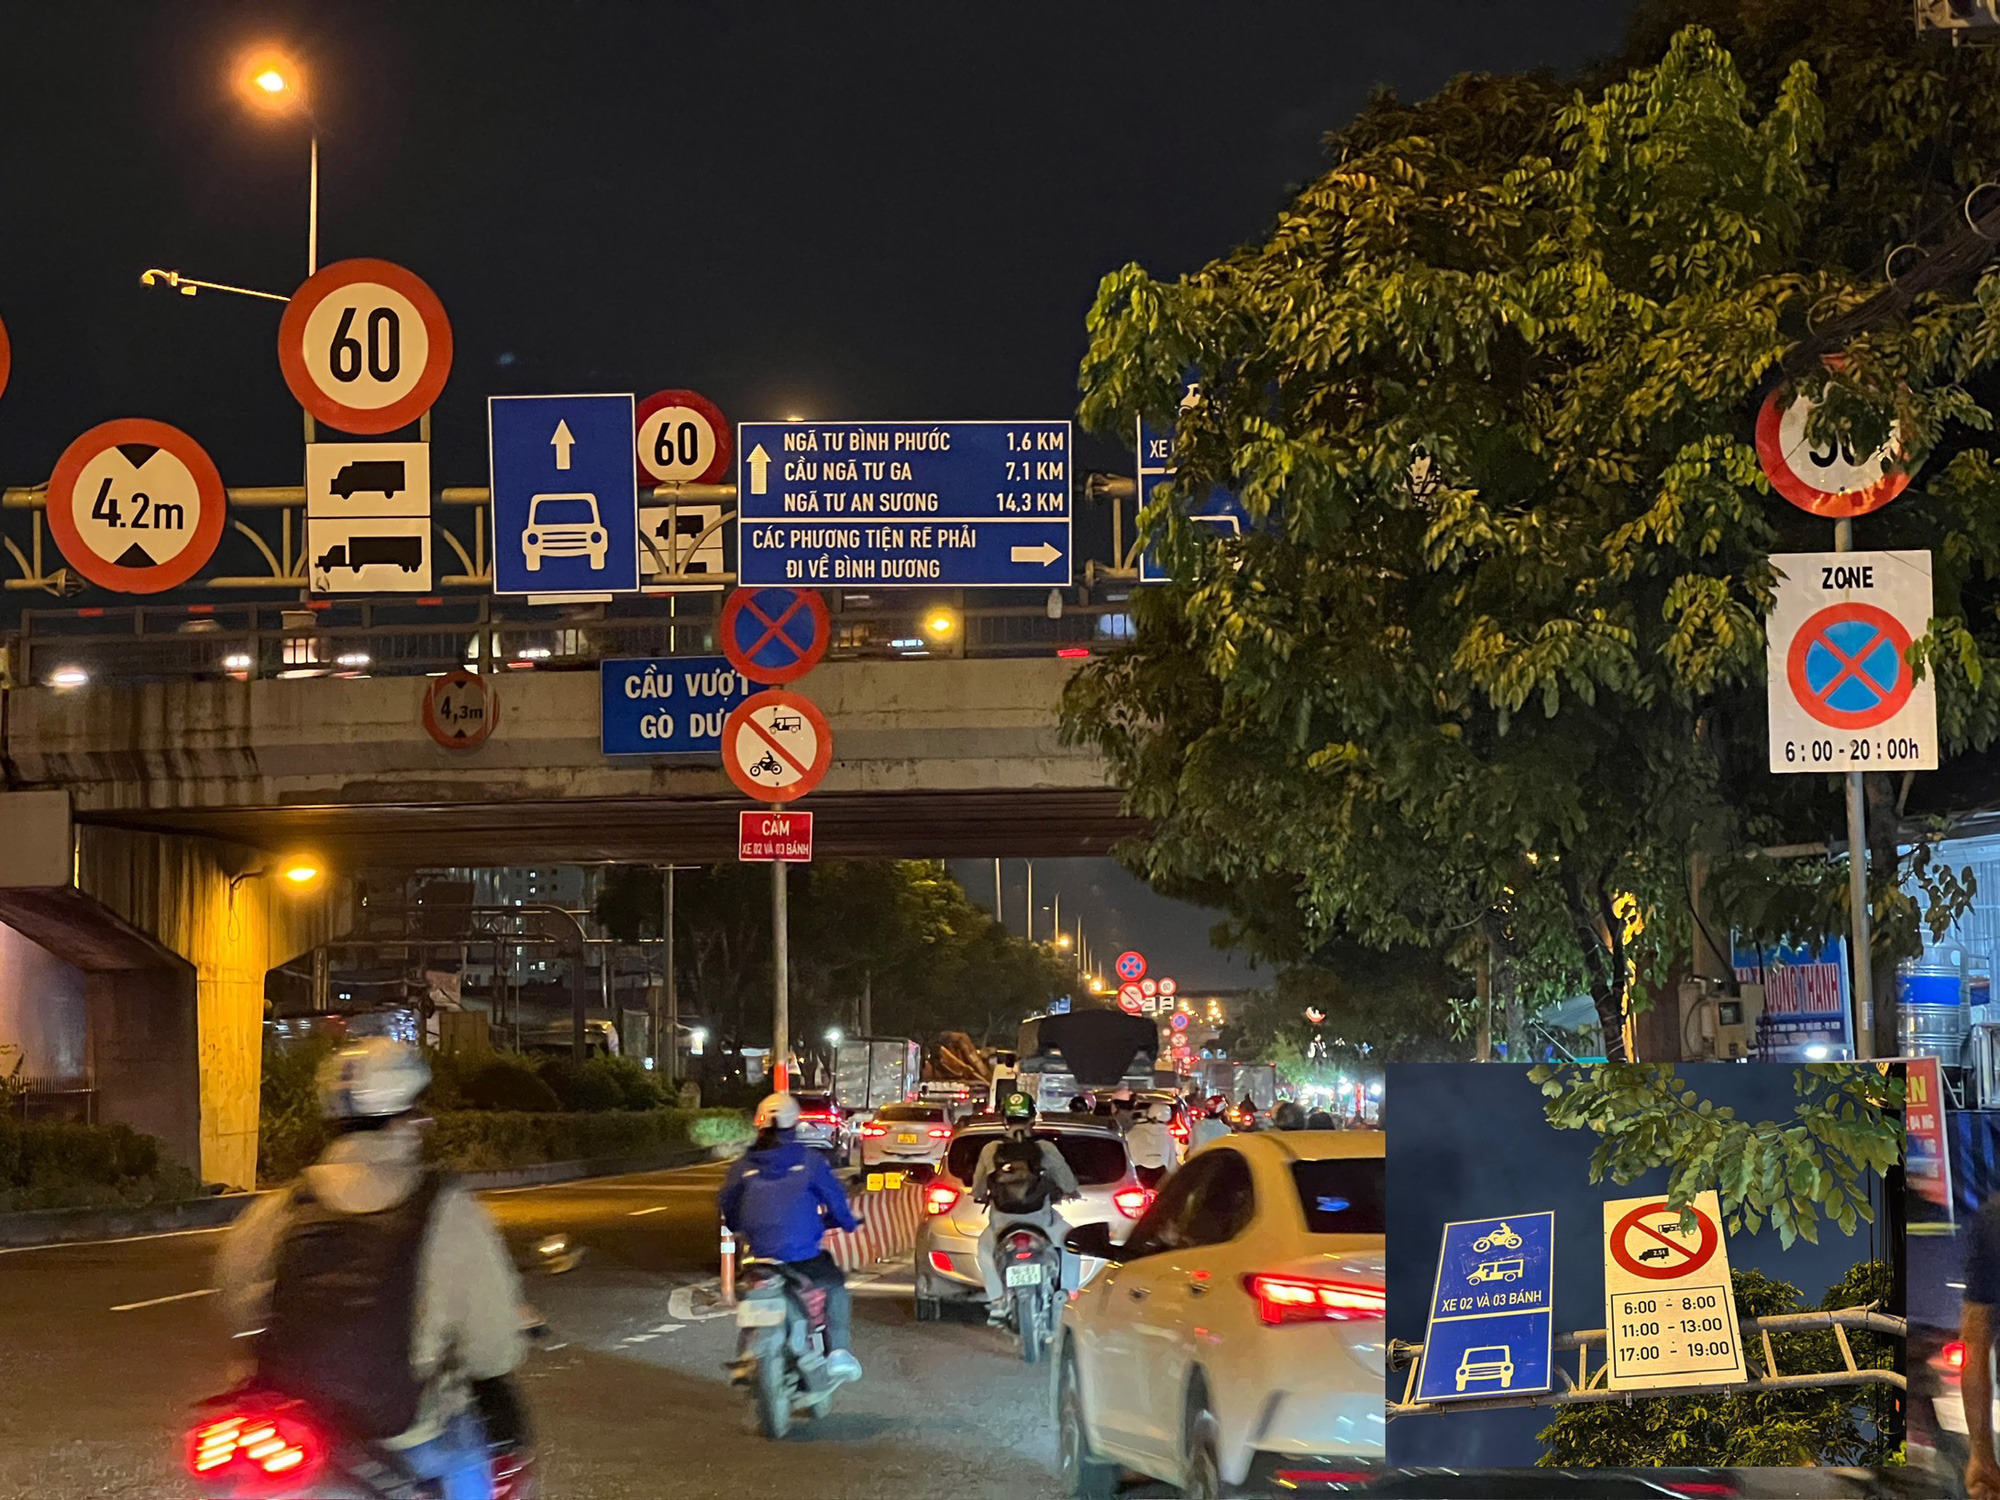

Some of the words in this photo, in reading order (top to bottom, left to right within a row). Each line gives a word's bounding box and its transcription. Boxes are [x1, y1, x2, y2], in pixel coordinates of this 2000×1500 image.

[329, 307, 400, 383] 60
[654, 422, 698, 466] 60
[784, 430, 818, 451] NGÃ
[823, 432, 845, 451] TƯ
[850, 429, 888, 451] BÌNH
[895, 428, 950, 451] PHƯỚC
[1007, 432, 1031, 452] 1,6
[1037, 432, 1064, 450] KM
[1150, 440, 1168, 458] XE
[784, 456, 817, 481] CẦU
[823, 459, 858, 481] NGÃ
[863, 461, 885, 480] TƯ
[890, 462, 912, 480] GA
[1006, 462, 1030, 482] 7,1
[1037, 462, 1063, 480] KM
[91, 477, 184, 530] 4.2m
[784, 490, 818, 512] NGÃ
[823, 493, 846, 512] TƯ
[852, 494, 874, 512] AN
[879, 492, 938, 512] SƯƠNG
[996, 493, 1031, 514] 14,3
[1037, 494, 1063, 511] KM
[752, 525, 785, 548] CÁC
[790, 529, 860, 548] PHƯƠNG
[865, 526, 904, 551] TIỆN
[911, 527, 932, 548] RẼ
[938, 525, 976, 548] PHẢI
[786, 559, 803, 578] ĐI
[808, 553, 830, 578] VỀ
[835, 554, 875, 578] BÌNH
[881, 559, 940, 578] DƯƠNG
[1822, 566, 1874, 589] ZONE
[625, 664, 673, 698] CẦU
[685, 667, 749, 702] VƯỢT
[441, 696, 483, 724] 4,3m
[640, 708, 674, 739] GÒ
[690, 708, 732, 738] DƯ
[742, 843, 753, 855] XE
[753, 843, 763, 855] 02
[764, 840, 773, 855] VÀ
[775, 843, 785, 855] 03
[786, 840, 809, 855] BÁNH
[1441, 1298, 1457, 1312] XE
[1460, 1297, 1473, 1310] 02
[1476, 1292, 1490, 1308] VÀ
[1493, 1293, 1506, 1306] 03
[1509, 1289, 1542, 1305] BÁNH
[1624, 1300, 1657, 1315] 6:00
[1682, 1295, 1716, 1311] 8:00
[1622, 1322, 1659, 1338] 11:00
[1680, 1317, 1722, 1333] 13:00
[1619, 1346, 1659, 1362] 17:00
[1687, 1341, 1729, 1357] 19:00
